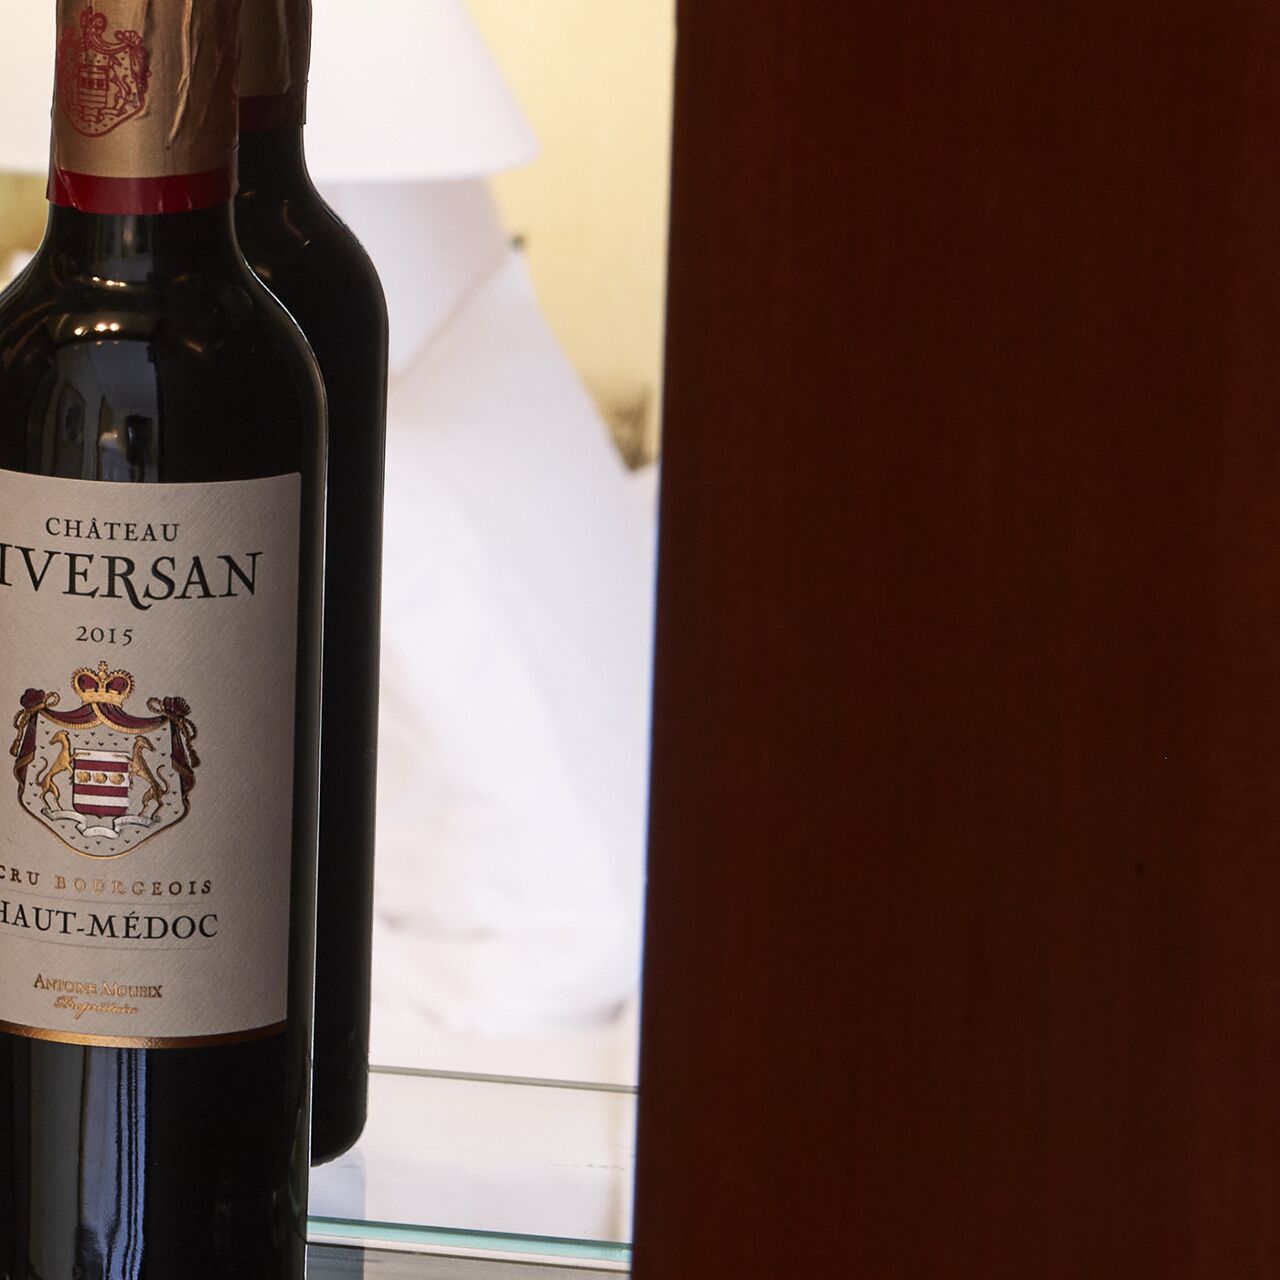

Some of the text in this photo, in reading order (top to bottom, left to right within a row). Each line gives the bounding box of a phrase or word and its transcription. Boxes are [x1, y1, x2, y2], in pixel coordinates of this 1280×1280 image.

[45, 516, 181, 543] CHÂTEAU
[75, 625, 134, 647] 2015
[54, 874, 213, 896] BOURGEOIS
